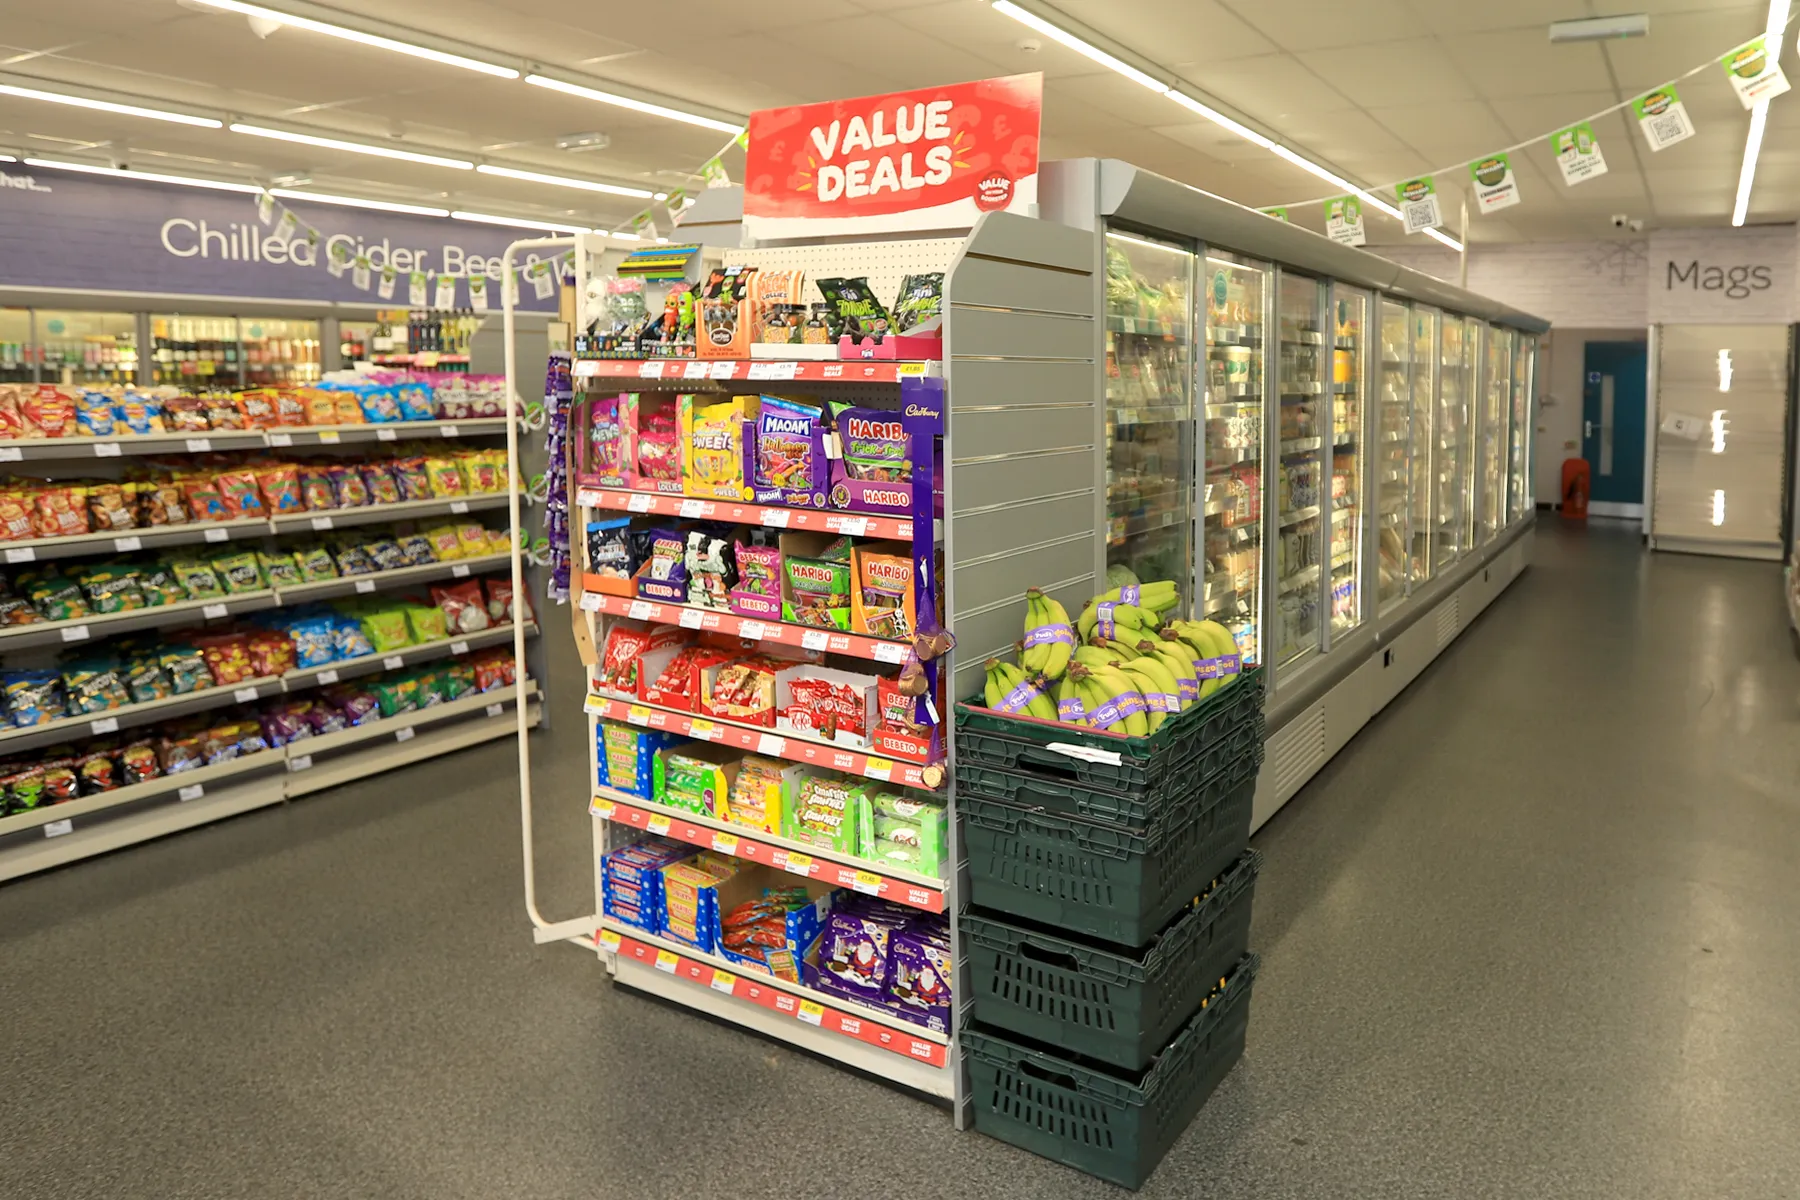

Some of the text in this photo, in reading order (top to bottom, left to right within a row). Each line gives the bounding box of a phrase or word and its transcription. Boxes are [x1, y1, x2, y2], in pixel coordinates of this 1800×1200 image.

[810, 100, 953, 161] VALUE
[817, 145, 953, 202] DEALS
[978, 177, 1011, 191] VALUE
[161, 218, 316, 266] Chilled
[326, 234, 435, 281] Cider,
[1667, 260, 1772, 299] Mags
[837, 299, 875, 317] ZOMBIE
[905, 404, 939, 419] Cadbury
[766, 417, 809, 436] MAOAM
[850, 441, 877, 455] Trick
[758, 490, 781, 501] MAOAM
[863, 489, 909, 507] HARIBO
[654, 538, 683, 552] BEBETO
[739, 552, 770, 565] BEBETO
[790, 563, 833, 582] HARIBO
[868, 561, 909, 582] HARIBO
[646, 583, 673, 597] BEBETO
[740, 597, 769, 612] BEBETO
[883, 737, 917, 754] BEBETO
[834, 753, 854, 761] VALUE
[834, 760, 853, 768] DEALS
[905, 769, 922, 777] VALU
[905, 774, 922, 783] DEAL
[613, 862, 637, 875] HARIBO
[614, 884, 638, 897] HARIBO
[909, 889, 930, 898] VALUE
[908, 895, 929, 905] DEALS
[616, 906, 639, 920] HARIBO
[832, 918, 856, 932] Cadbury
[893, 943, 918, 958] Cadbury
[742, 959, 770, 976] HARIBO
[776, 995, 795, 1004] VALUE
[776, 1001, 794, 1011] DEALS
[841, 1018, 861, 1027] VALUE
[841, 1024, 860, 1034] DEALS
[911, 1041, 932, 1051] VALUE
[911, 1047, 931, 1058] DEALS
